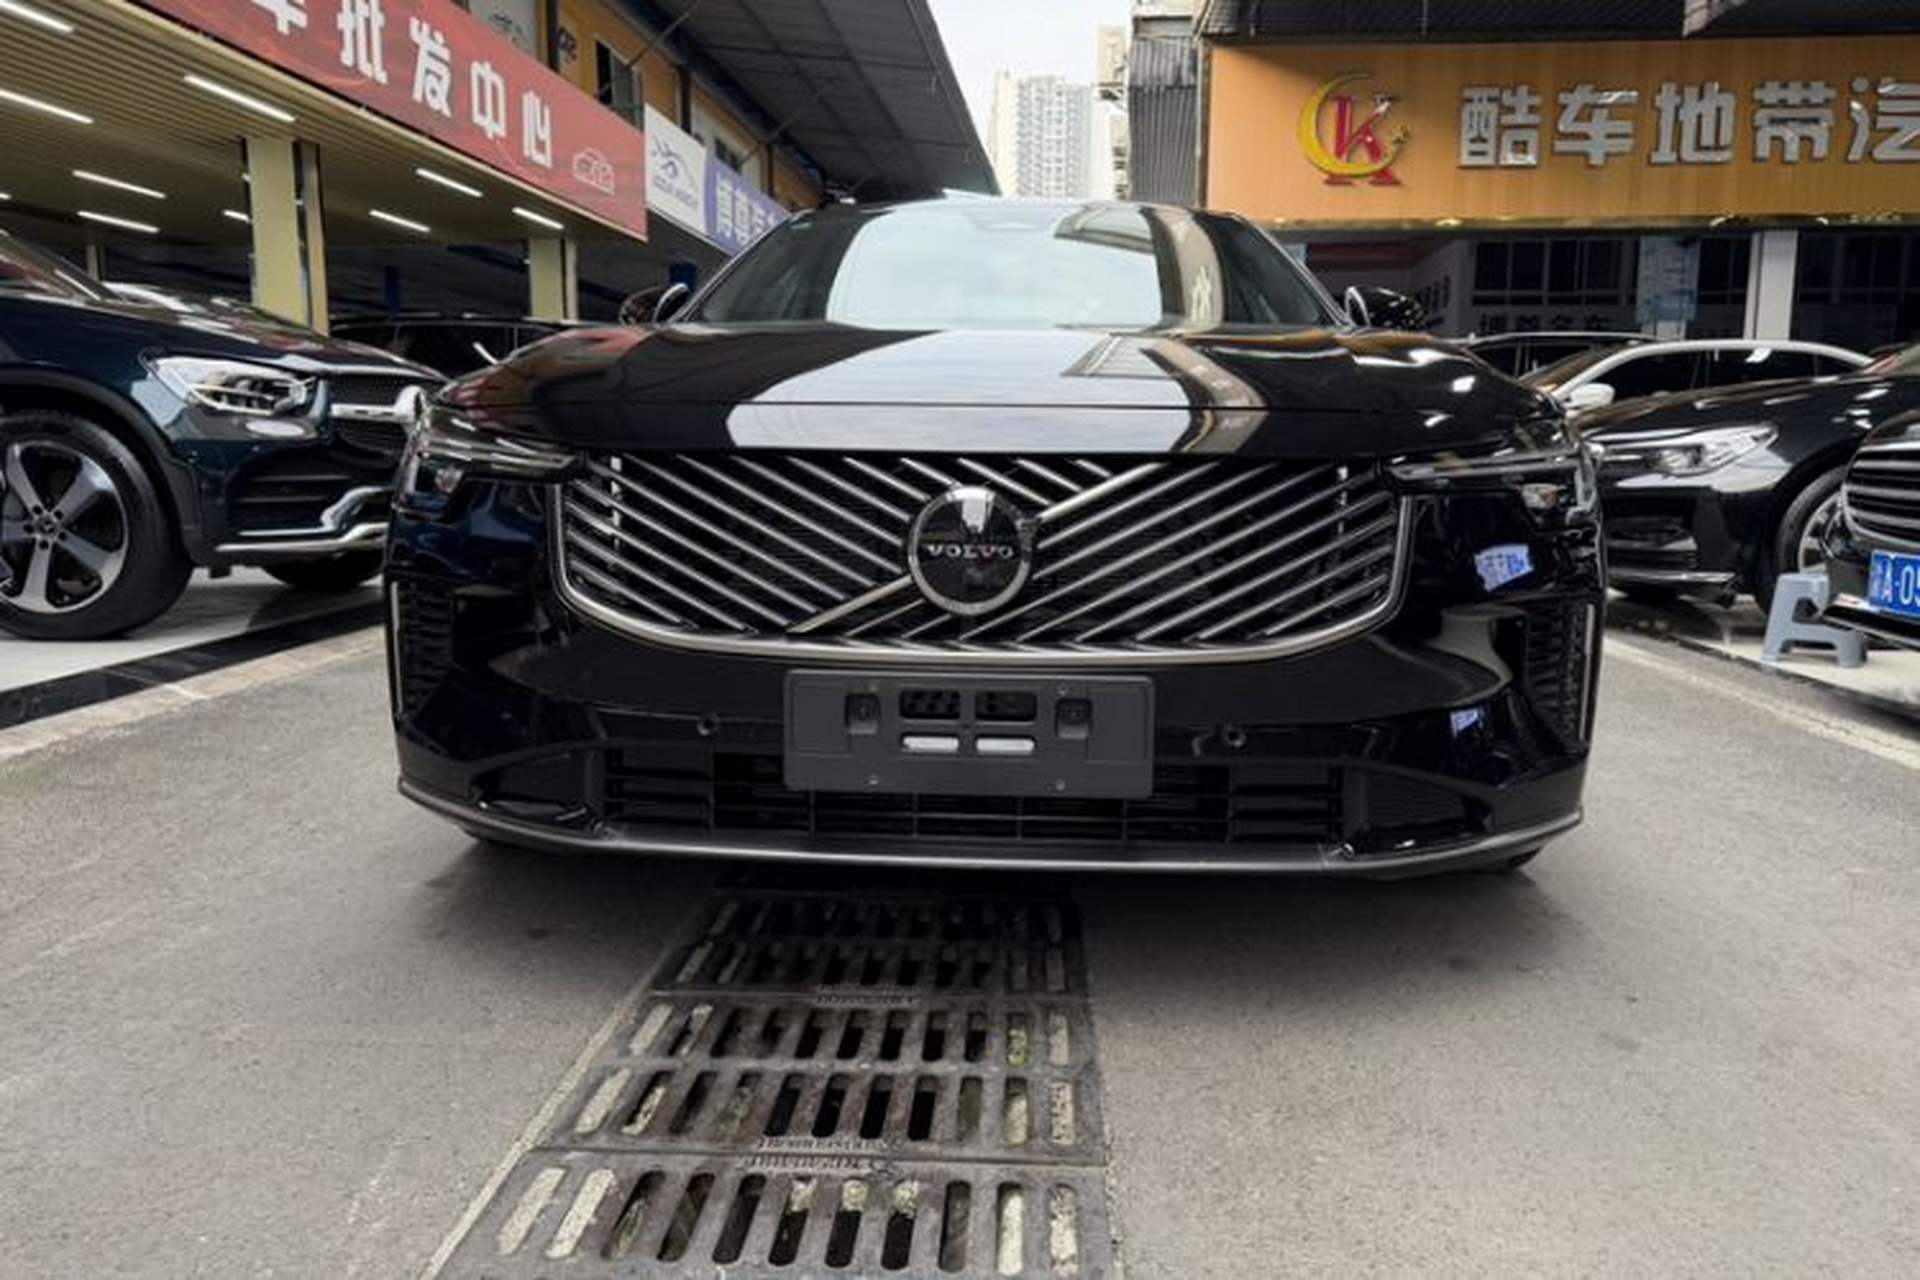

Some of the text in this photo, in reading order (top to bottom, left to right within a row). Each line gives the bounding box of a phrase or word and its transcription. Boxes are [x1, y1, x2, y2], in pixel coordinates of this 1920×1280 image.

[1459, 77, 1920, 167] 酷车地带汽
[926, 543, 1014, 559] VOLVO
